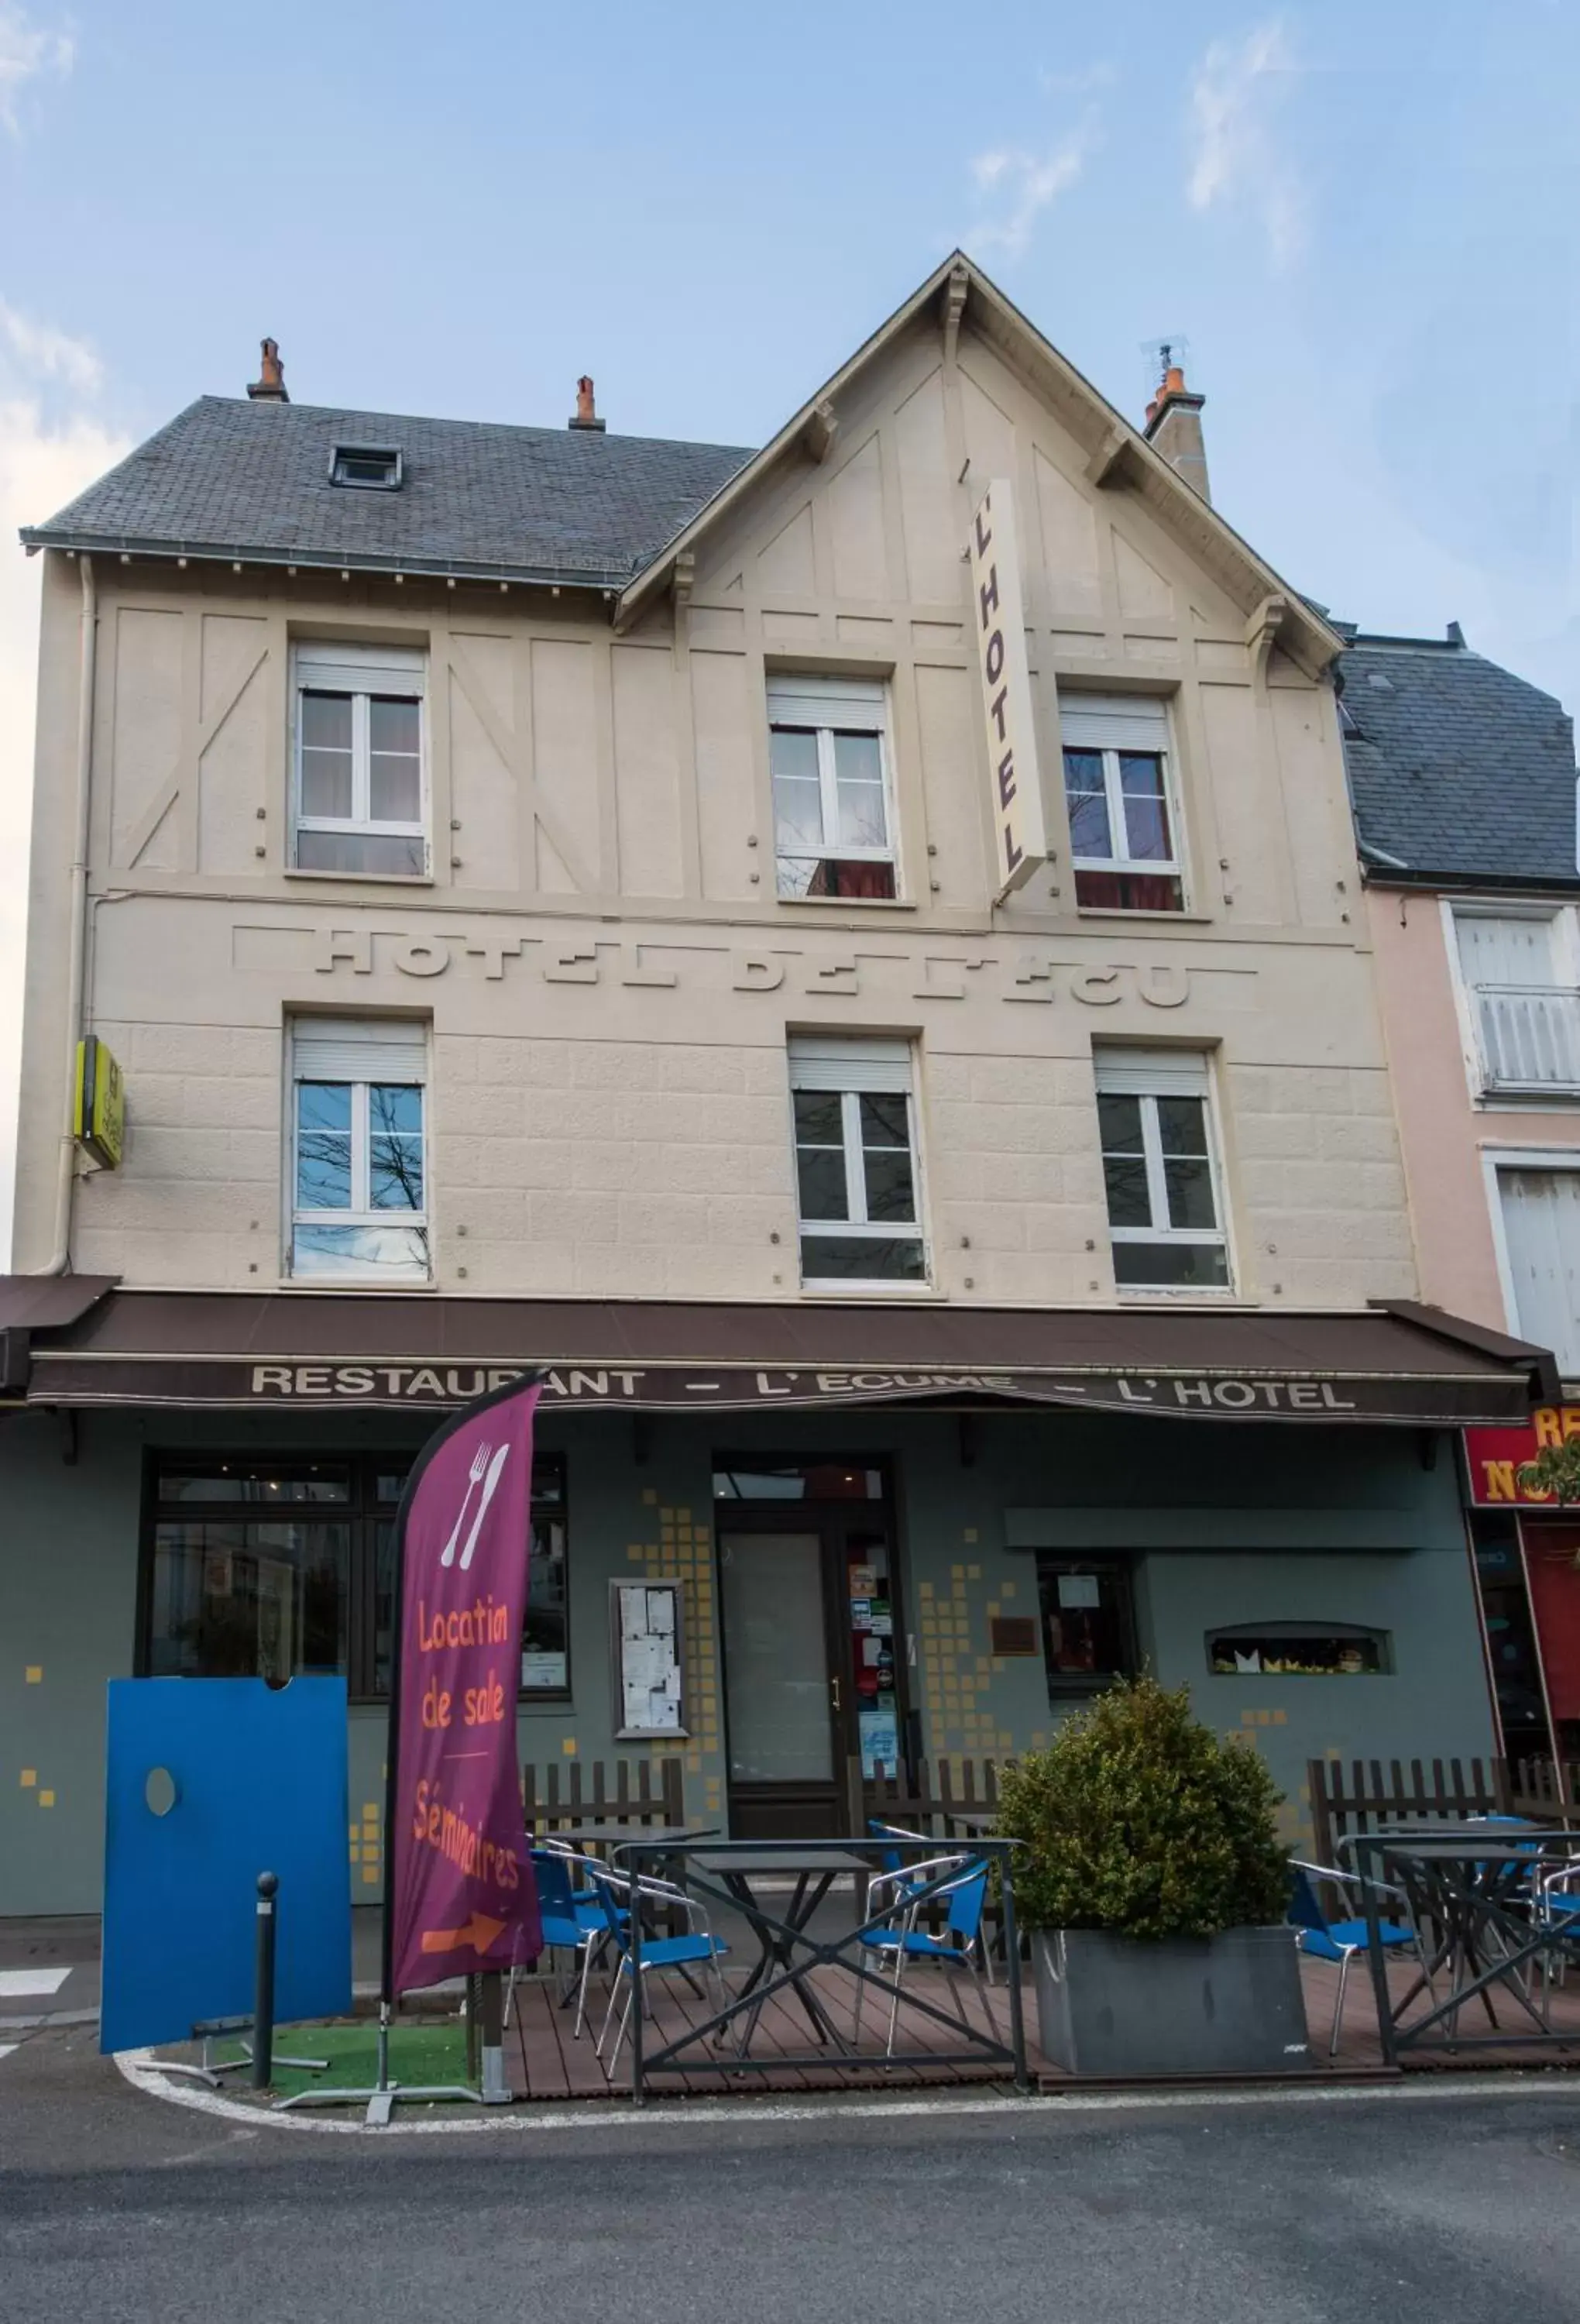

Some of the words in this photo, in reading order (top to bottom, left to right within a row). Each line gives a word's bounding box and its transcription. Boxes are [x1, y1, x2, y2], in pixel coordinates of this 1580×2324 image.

[313, 930, 677, 988] HOTEL
[732, 947, 859, 996] DE
[422, 1673, 452, 1728] de
